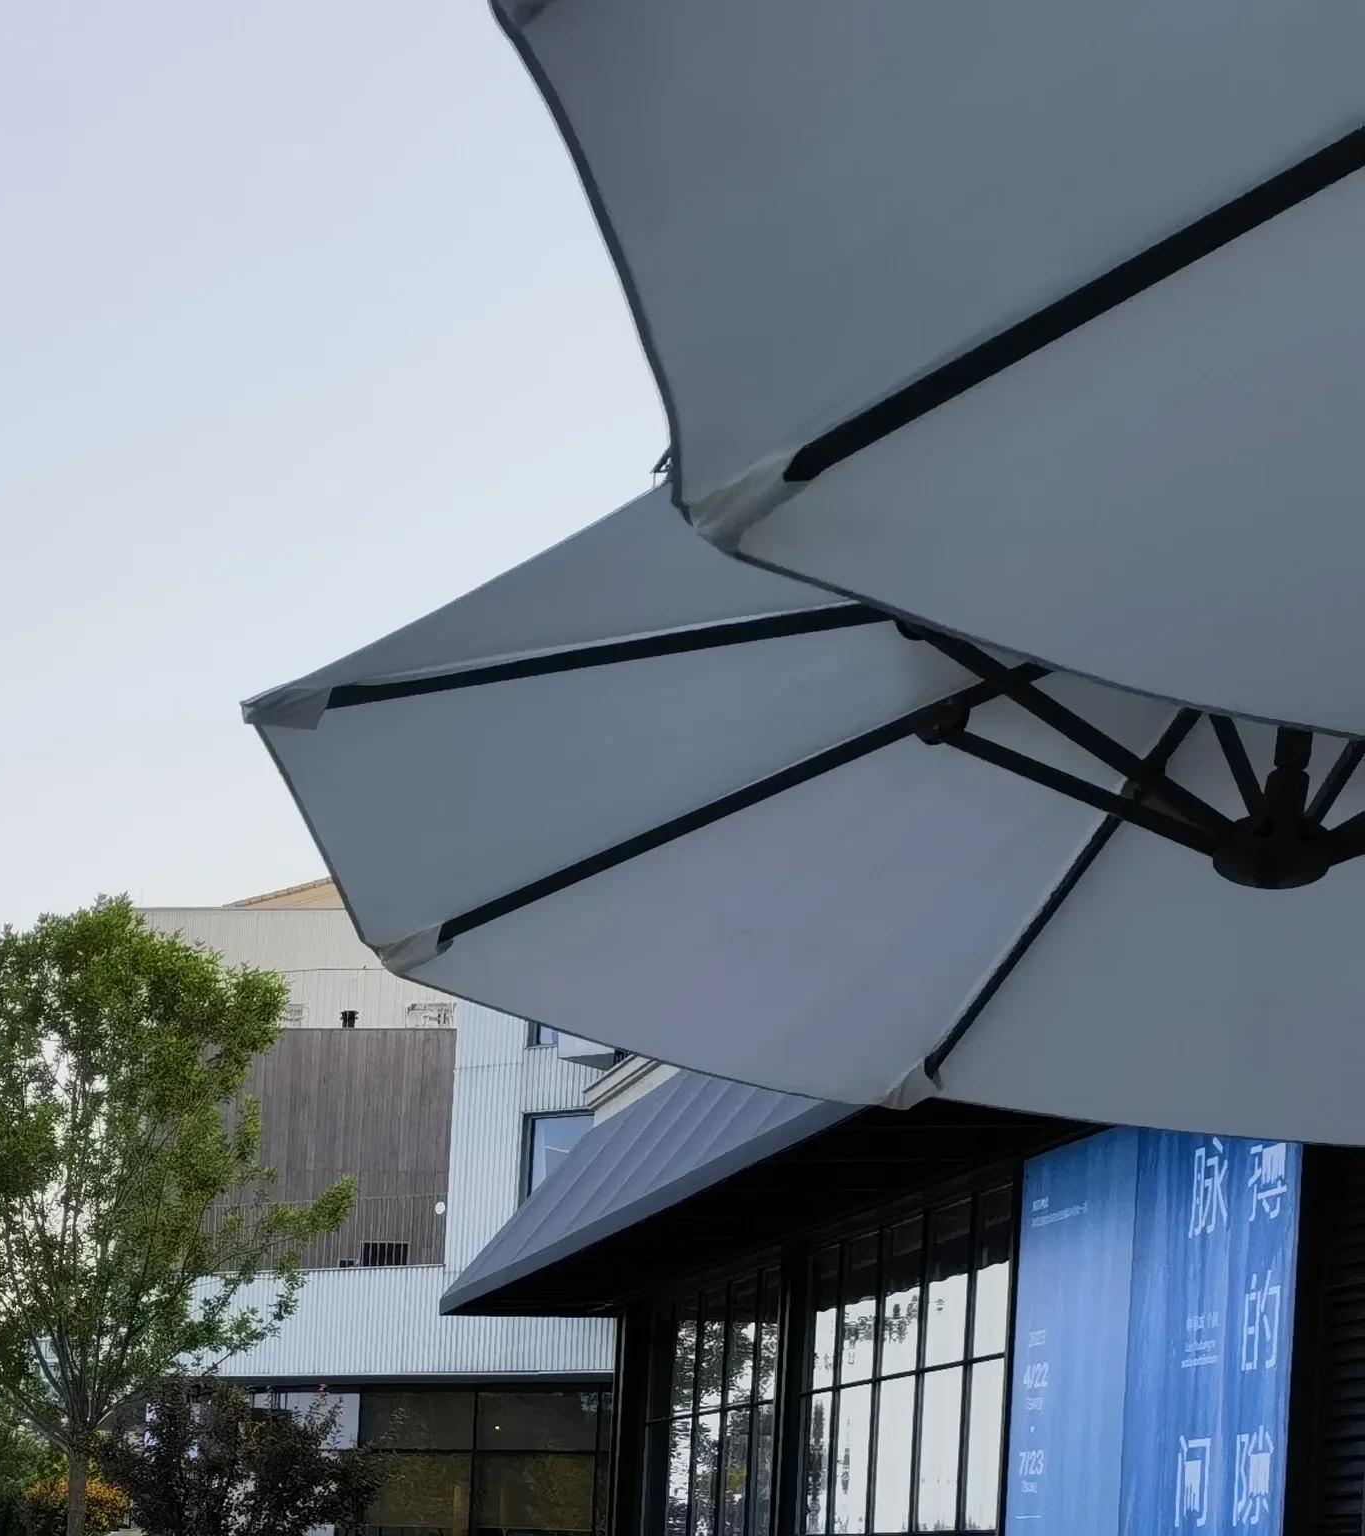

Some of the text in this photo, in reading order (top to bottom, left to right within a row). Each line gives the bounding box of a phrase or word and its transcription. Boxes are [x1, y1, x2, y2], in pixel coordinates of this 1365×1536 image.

[1240, 1268, 1282, 1371] 的
[1022, 1362, 1050, 1390] 4/22
[1018, 1448, 1045, 1476] 7/23
